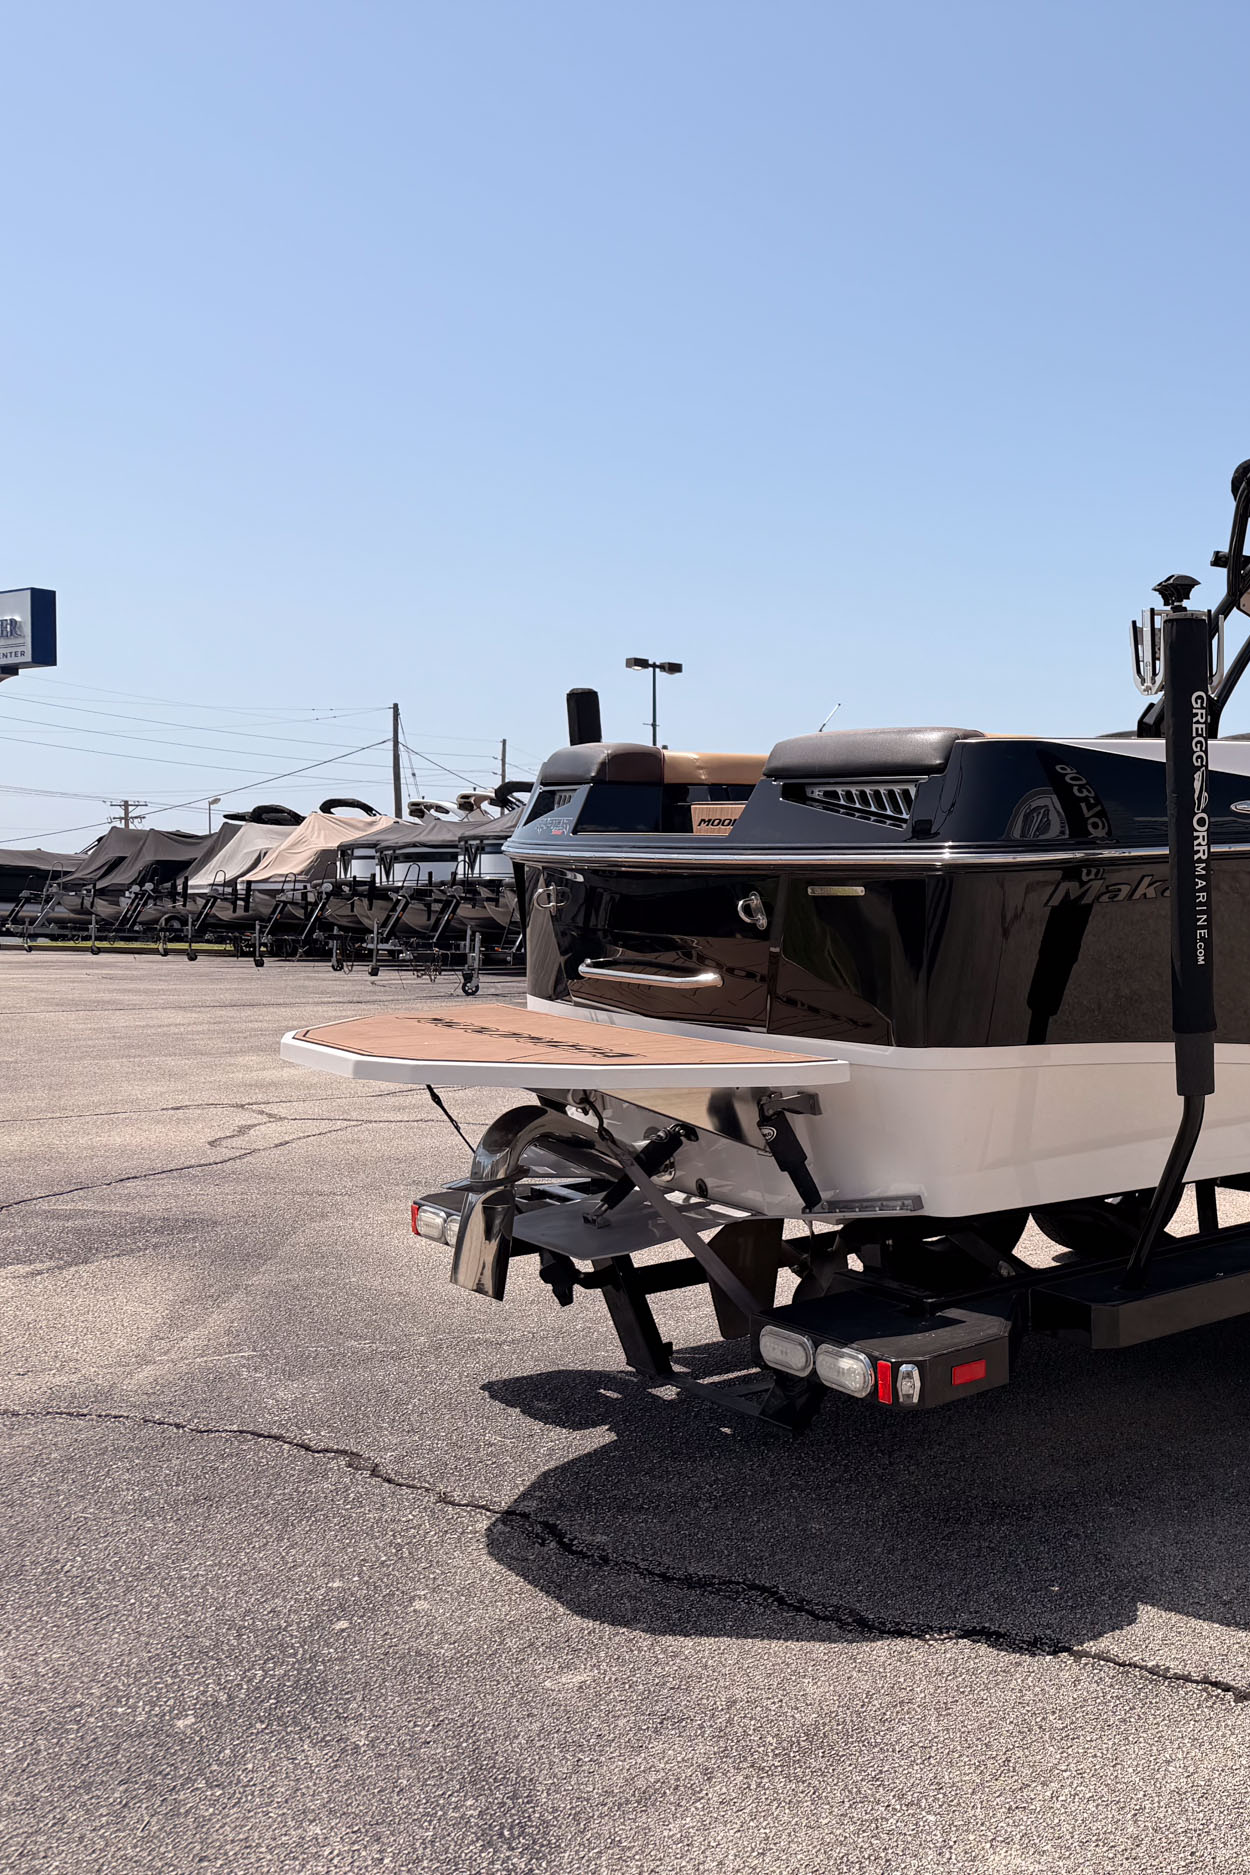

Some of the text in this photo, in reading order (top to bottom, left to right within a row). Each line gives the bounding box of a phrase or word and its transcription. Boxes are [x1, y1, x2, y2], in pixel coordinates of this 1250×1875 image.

[0, 650, 26, 660] NTER
[1191, 690, 1207, 767] GREGG
[1192, 812, 1209, 861] ORR
